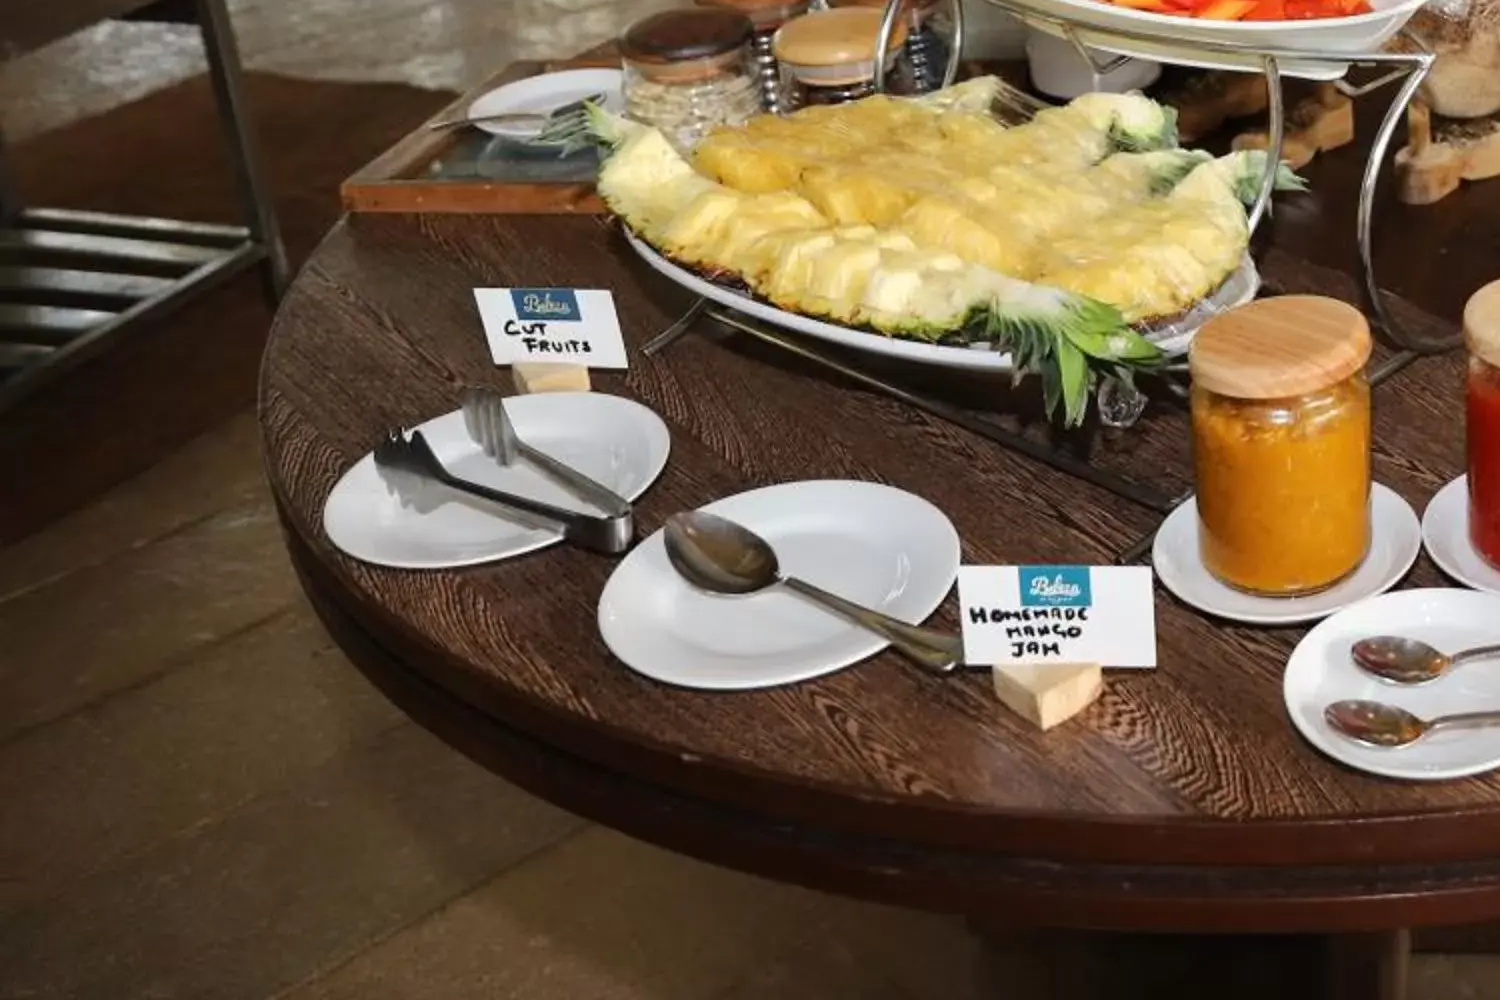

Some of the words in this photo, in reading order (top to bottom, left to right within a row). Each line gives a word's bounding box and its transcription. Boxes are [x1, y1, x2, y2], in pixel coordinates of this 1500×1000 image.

[504, 319, 547, 336] CUT
[522, 337, 593, 353] FRUITS
[969, 606, 1089, 624] HOMEMADE
[1006, 623, 1082, 639] MANGO
[1011, 641, 1060, 658] JAM
